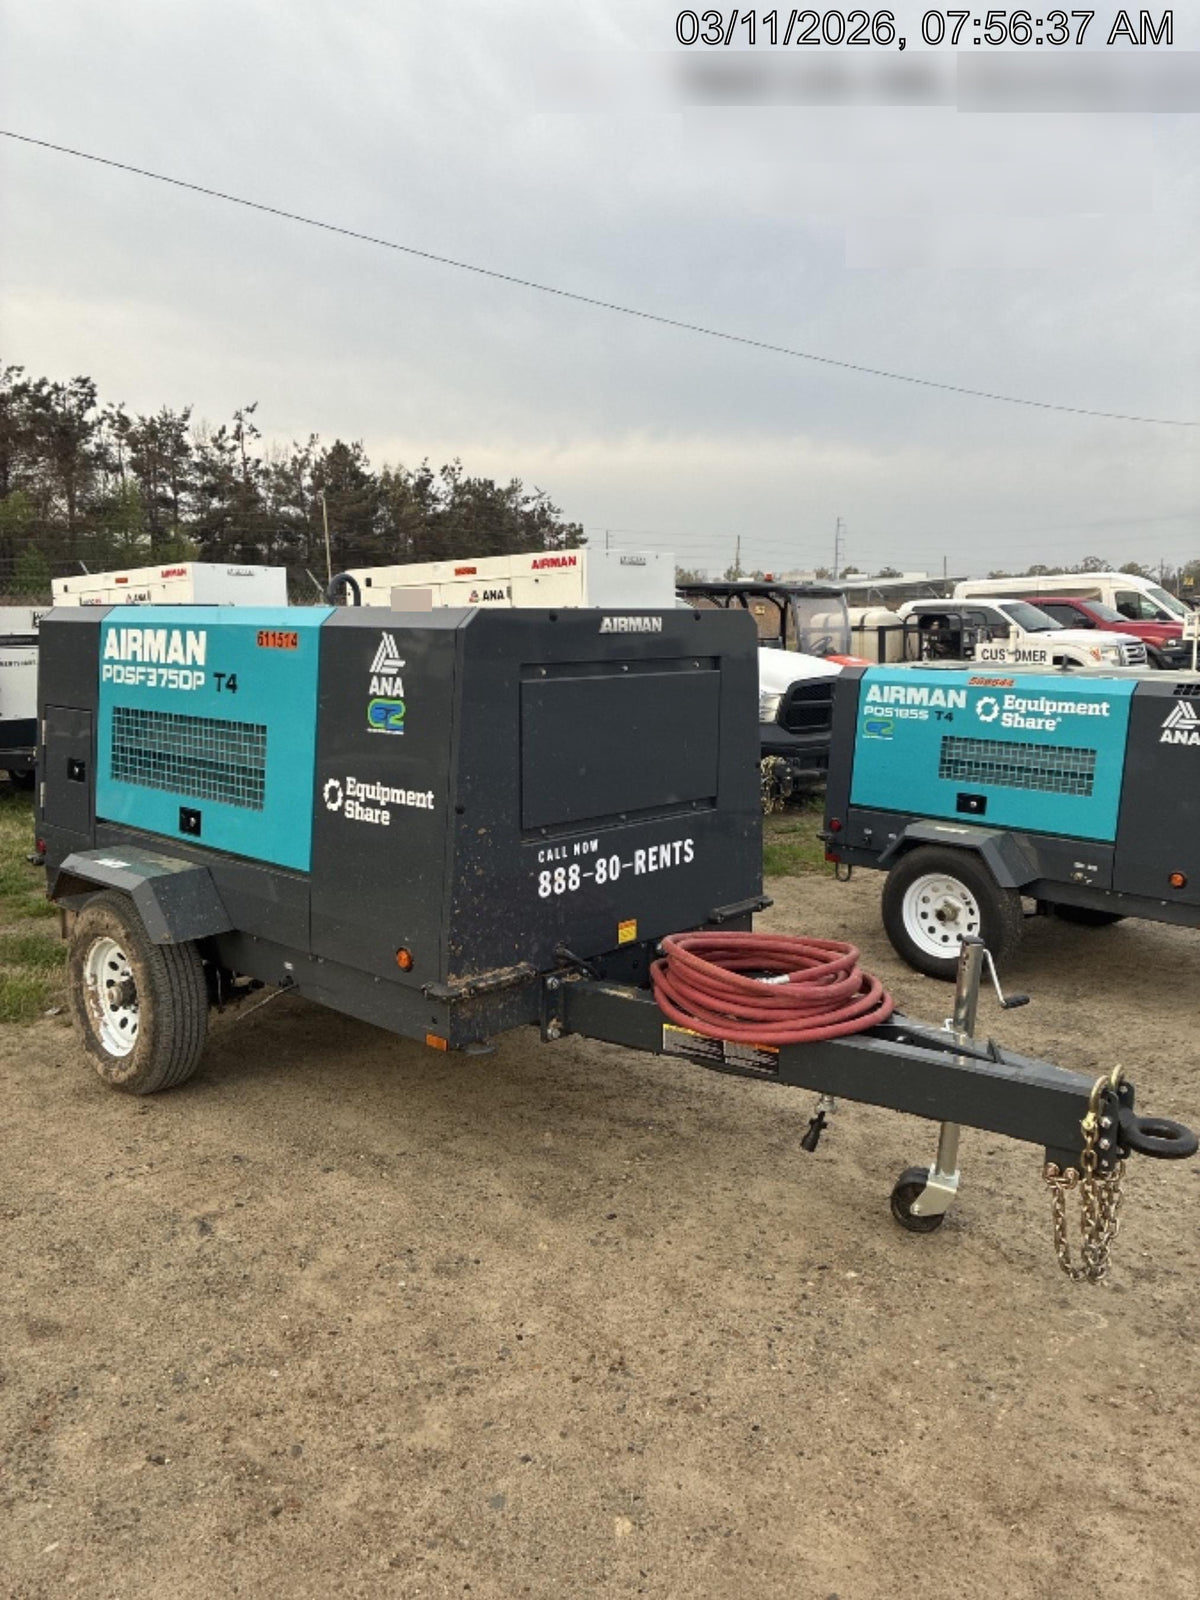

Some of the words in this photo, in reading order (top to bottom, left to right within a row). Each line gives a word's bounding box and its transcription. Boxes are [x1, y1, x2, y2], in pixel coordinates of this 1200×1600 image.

[531, 555, 577, 570] AIRMAN
[482, 589, 505, 602] ANA
[599, 616, 663, 634] AIRMAN
[103, 628, 207, 666] AIRMAN
[981, 648, 1047, 662] CUSOMER
[102, 664, 206, 691] PDSF375DP
[214, 673, 238, 694] T4
[368, 675, 405, 698] ANA
[865, 683, 968, 710] AIRMAN
[1003, 694, 1111, 718] Equipment
[934, 710, 954, 723] T4
[1159, 728, 1200, 746] ANA
[345, 776, 435, 811] Equipment
[344, 799, 391, 826] Share
[537, 845, 568, 863] CALL
[573, 838, 600, 856] NOW
[537, 837, 695, 899] 888-80-RENTS
